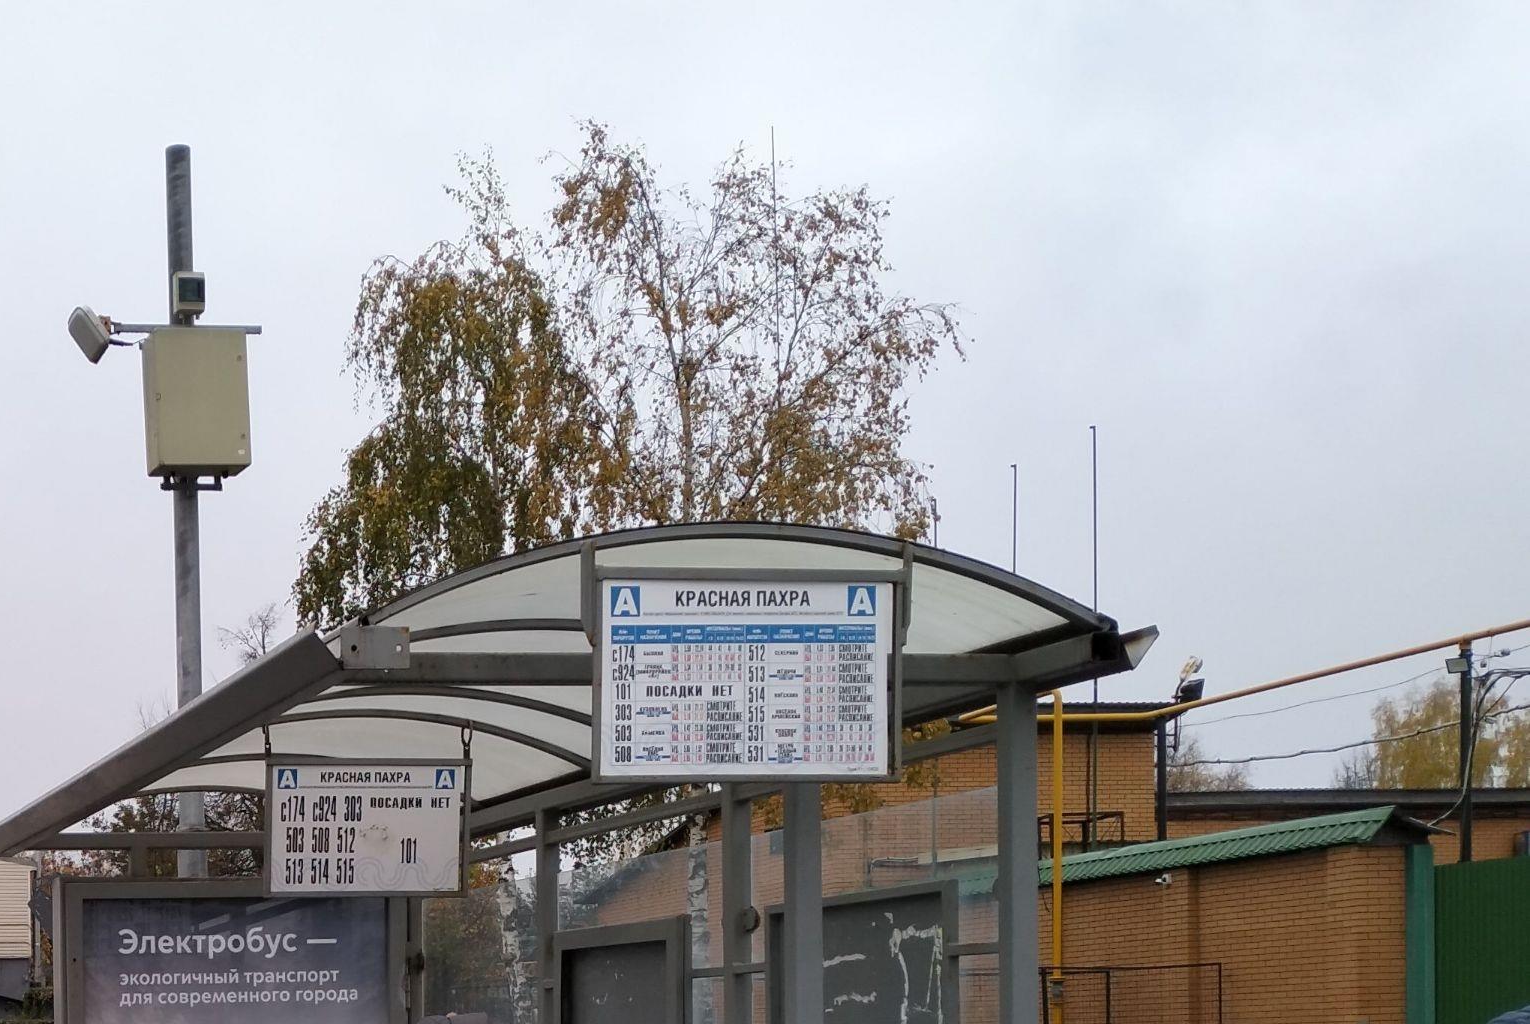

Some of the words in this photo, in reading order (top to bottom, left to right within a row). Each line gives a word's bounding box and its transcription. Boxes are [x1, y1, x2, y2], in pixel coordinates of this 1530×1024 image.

[675, 590, 751, 607] КРАСНАЯ
[756, 590, 811, 607] ПАХРА
[612, 645, 635, 663] с174
[748, 645, 766, 662] 512
[748, 666, 766, 683] 513
[615, 684, 631, 700] 101
[646, 685, 703, 698] ПОСАДКИ
[712, 685, 733, 697] НЕТ
[748, 686, 765, 703] 514
[615, 704, 632, 721] 303
[748, 706, 765, 723] 515
[615, 725, 632, 742] 503
[748, 725, 764, 742] 531
[614, 746, 632, 763] 508
[747, 745, 764, 762] 531
[320, 771, 371, 784] КРАСНАЯ
[374, 771, 411, 783] ПАХРА
[280, 796, 305, 822] с174
[312, 796, 337, 822] с924
[343, 796, 362, 822] 303
[370, 797, 422, 810] ПОСАДКИ
[430, 797, 451, 809] НЕТ
[286, 827, 305, 854] 503
[311, 827, 330, 854] 508
[337, 827, 355, 853] 512
[400, 838, 418, 864] 101
[285, 859, 304, 885] 513
[310, 859, 329, 885] 514
[336, 859, 354, 885] 515
[118, 927, 298, 959] Электробус
[119, 969, 239, 985] экологичный
[243, 969, 340, 986] транспорт
[119, 992, 153, 1007] для
[158, 991, 290, 1006] современного
[296, 989, 359, 1004] города
